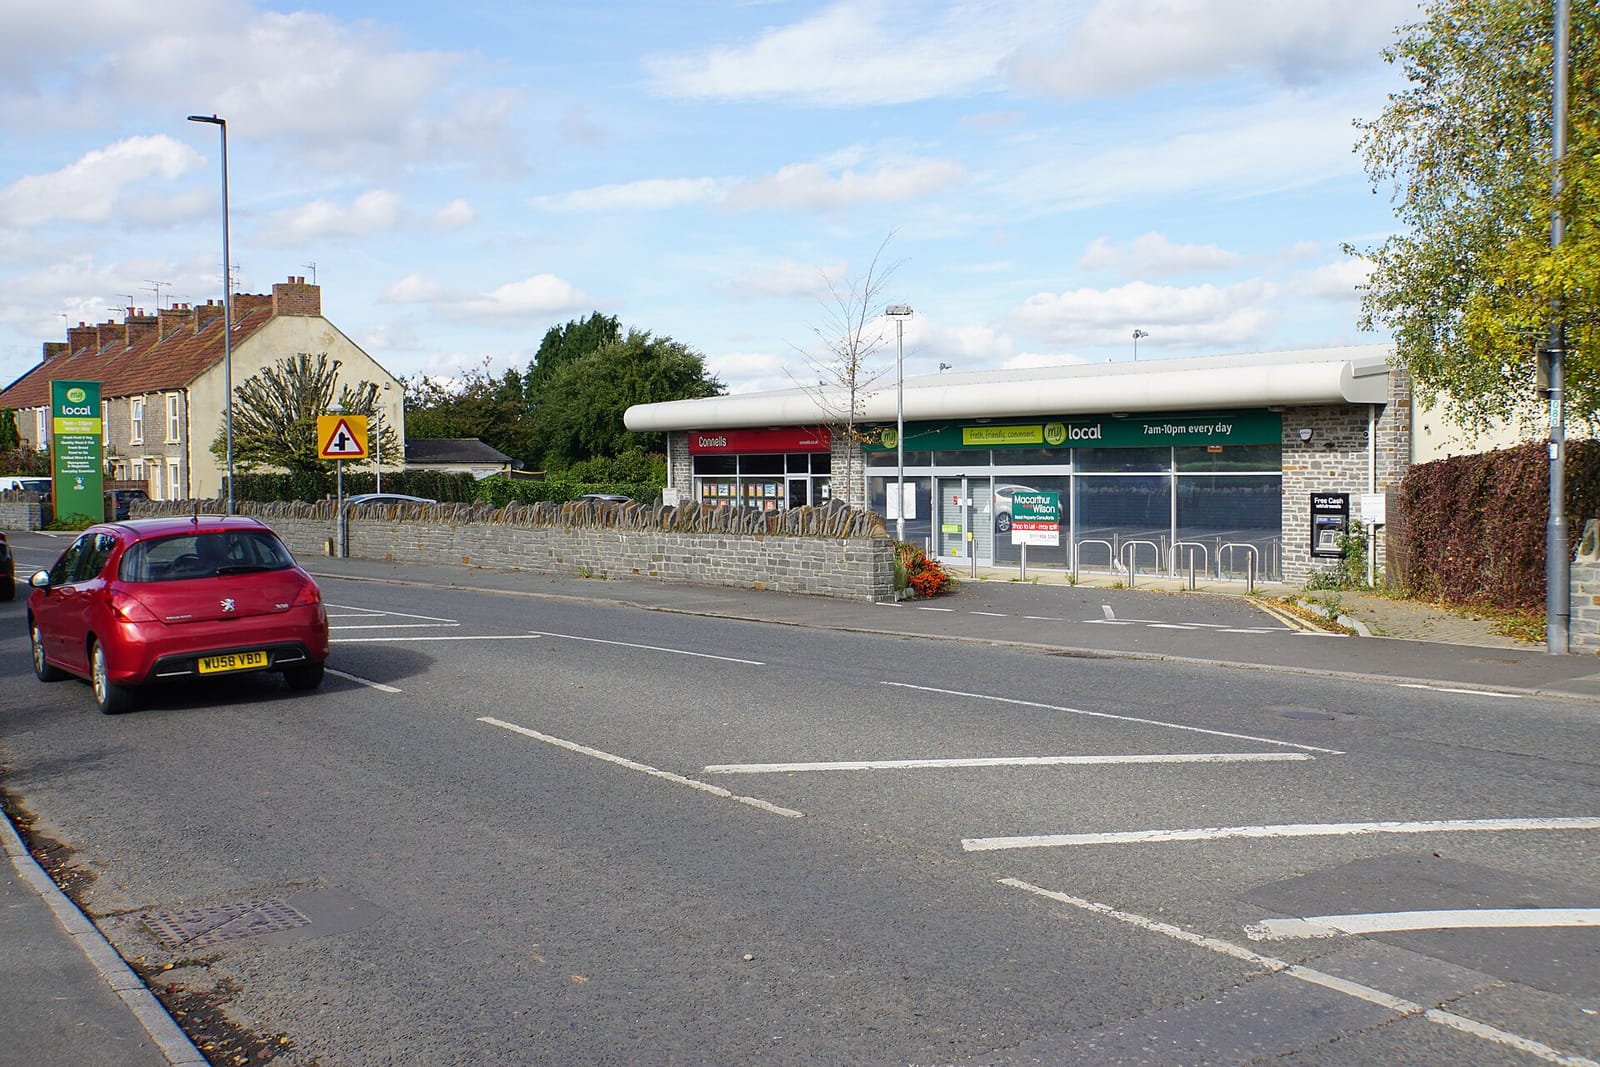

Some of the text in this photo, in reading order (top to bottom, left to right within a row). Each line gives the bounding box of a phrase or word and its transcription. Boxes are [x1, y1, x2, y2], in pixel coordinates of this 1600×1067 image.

[62, 405, 91, 415] local
[1048, 424, 1101, 444] my local
[1143, 422, 1232, 436] 7am-10pm every day
[698, 436, 726, 448] Connells
[884, 431, 896, 446] my
[1014, 495, 1050, 504] Macarthur
[1032, 504, 1056, 514] Wilson
[204, 652, 262, 669] WU58 VBD
